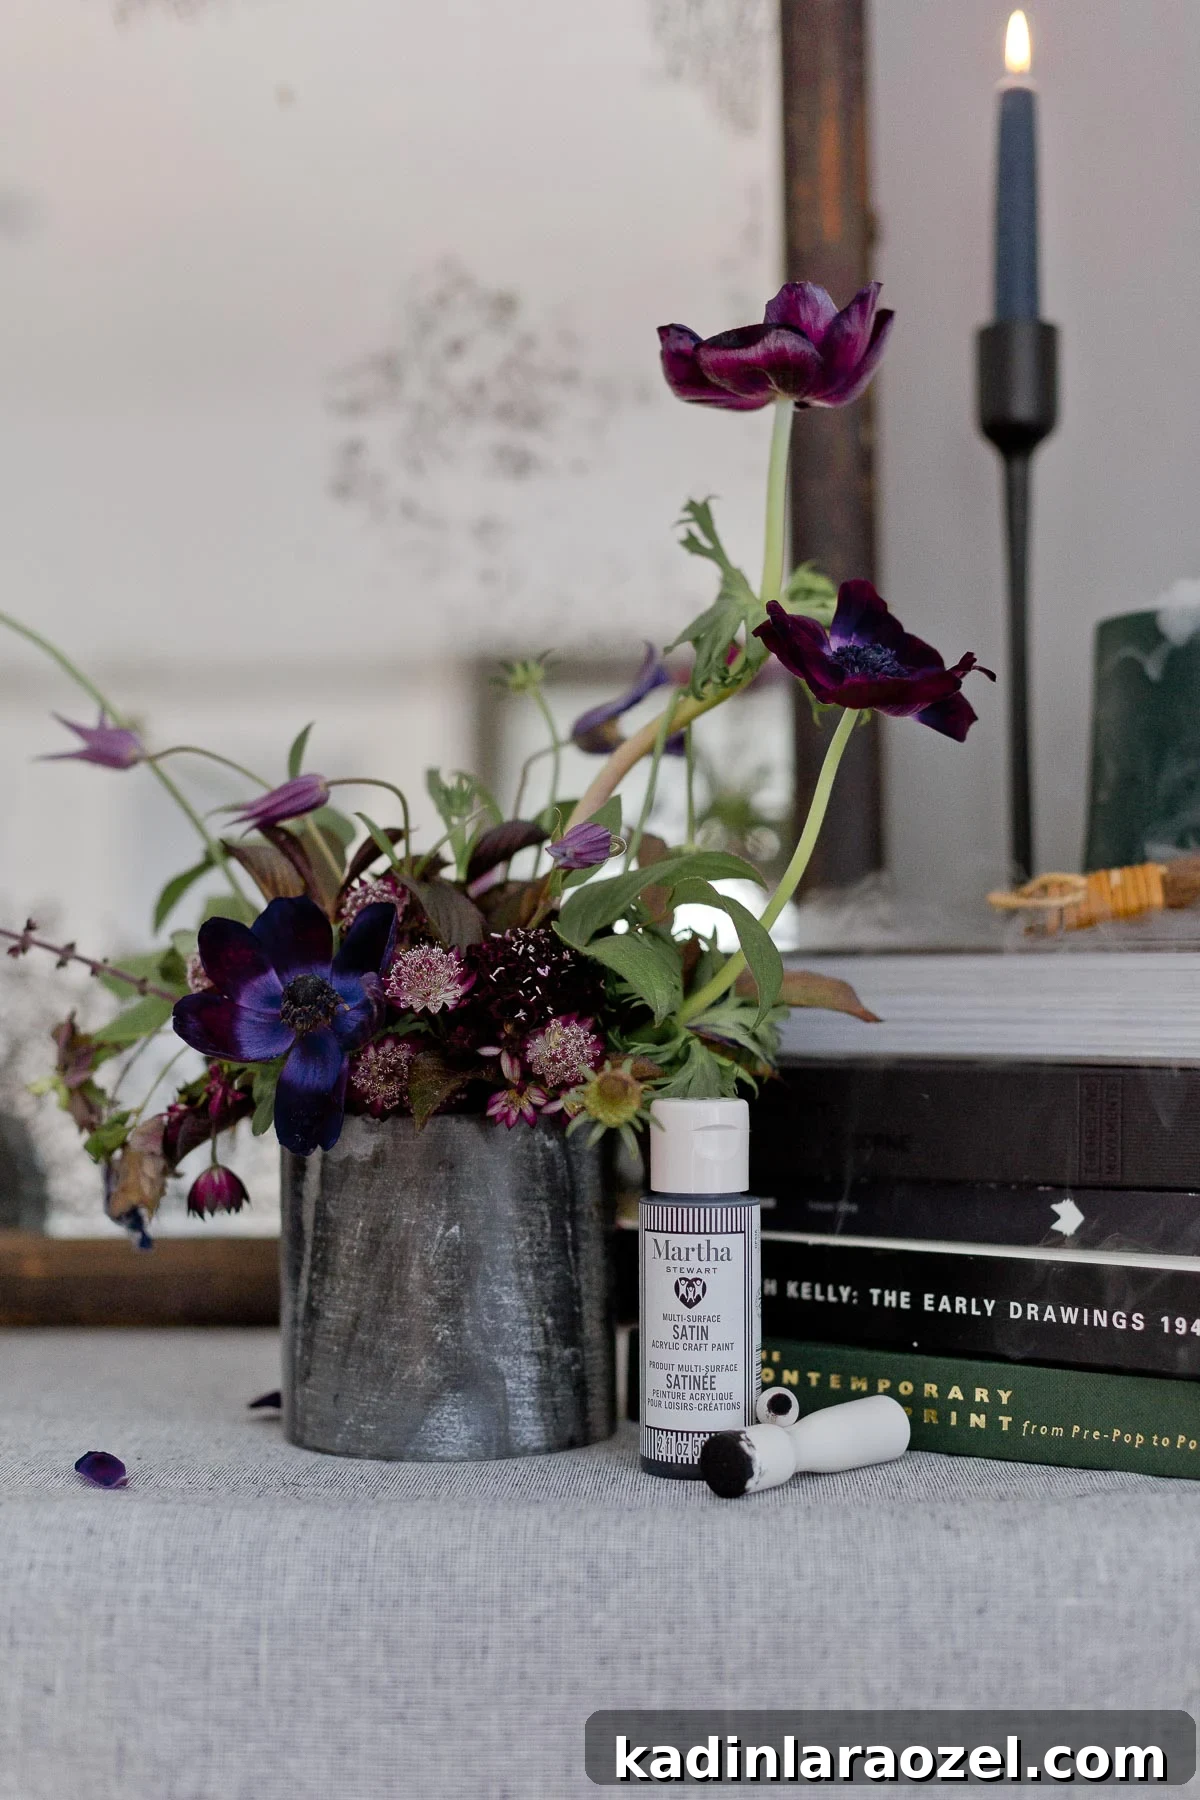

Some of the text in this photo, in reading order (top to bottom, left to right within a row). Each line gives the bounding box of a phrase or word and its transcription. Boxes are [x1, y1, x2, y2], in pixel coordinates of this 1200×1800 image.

[651, 1237, 733, 1262] Martha
[666, 1266, 718, 1274] STEWART
[786, 1280, 858, 1304] KELLY:
[869, 1288, 911, 1309] THE
[924, 1293, 995, 1317] EARLY
[1009, 1301, 1145, 1331] DRAWINGS
[662, 1313, 721, 1323] MULTI-SURFACE
[672, 1324, 709, 1341] SATIN
[651, 1340, 735, 1352] ACRYLIC CRAFT PAINT
[649, 1360, 738, 1373] PRODUIT MULTI-SURFACE
[666, 1373, 717, 1391] SATINÉE
[761, 1367, 1013, 1405] ONTEMPORARY
[652, 1389, 734, 1401] PEINTURE ACRYLIQUE
[647, 1398, 741, 1412] POUR LOISIRS-CRÉATIONS
[1022, 1420, 1064, 1437] from
[1071, 1424, 1144, 1448] Pre-Pop
[1152, 1434, 1170, 1447] to
[1176, 1434, 1197, 1450] Po
[657, 1436, 663, 1453] 2
[666, 1437, 673, 1455] fl
[676, 1443, 689, 1456] oz
